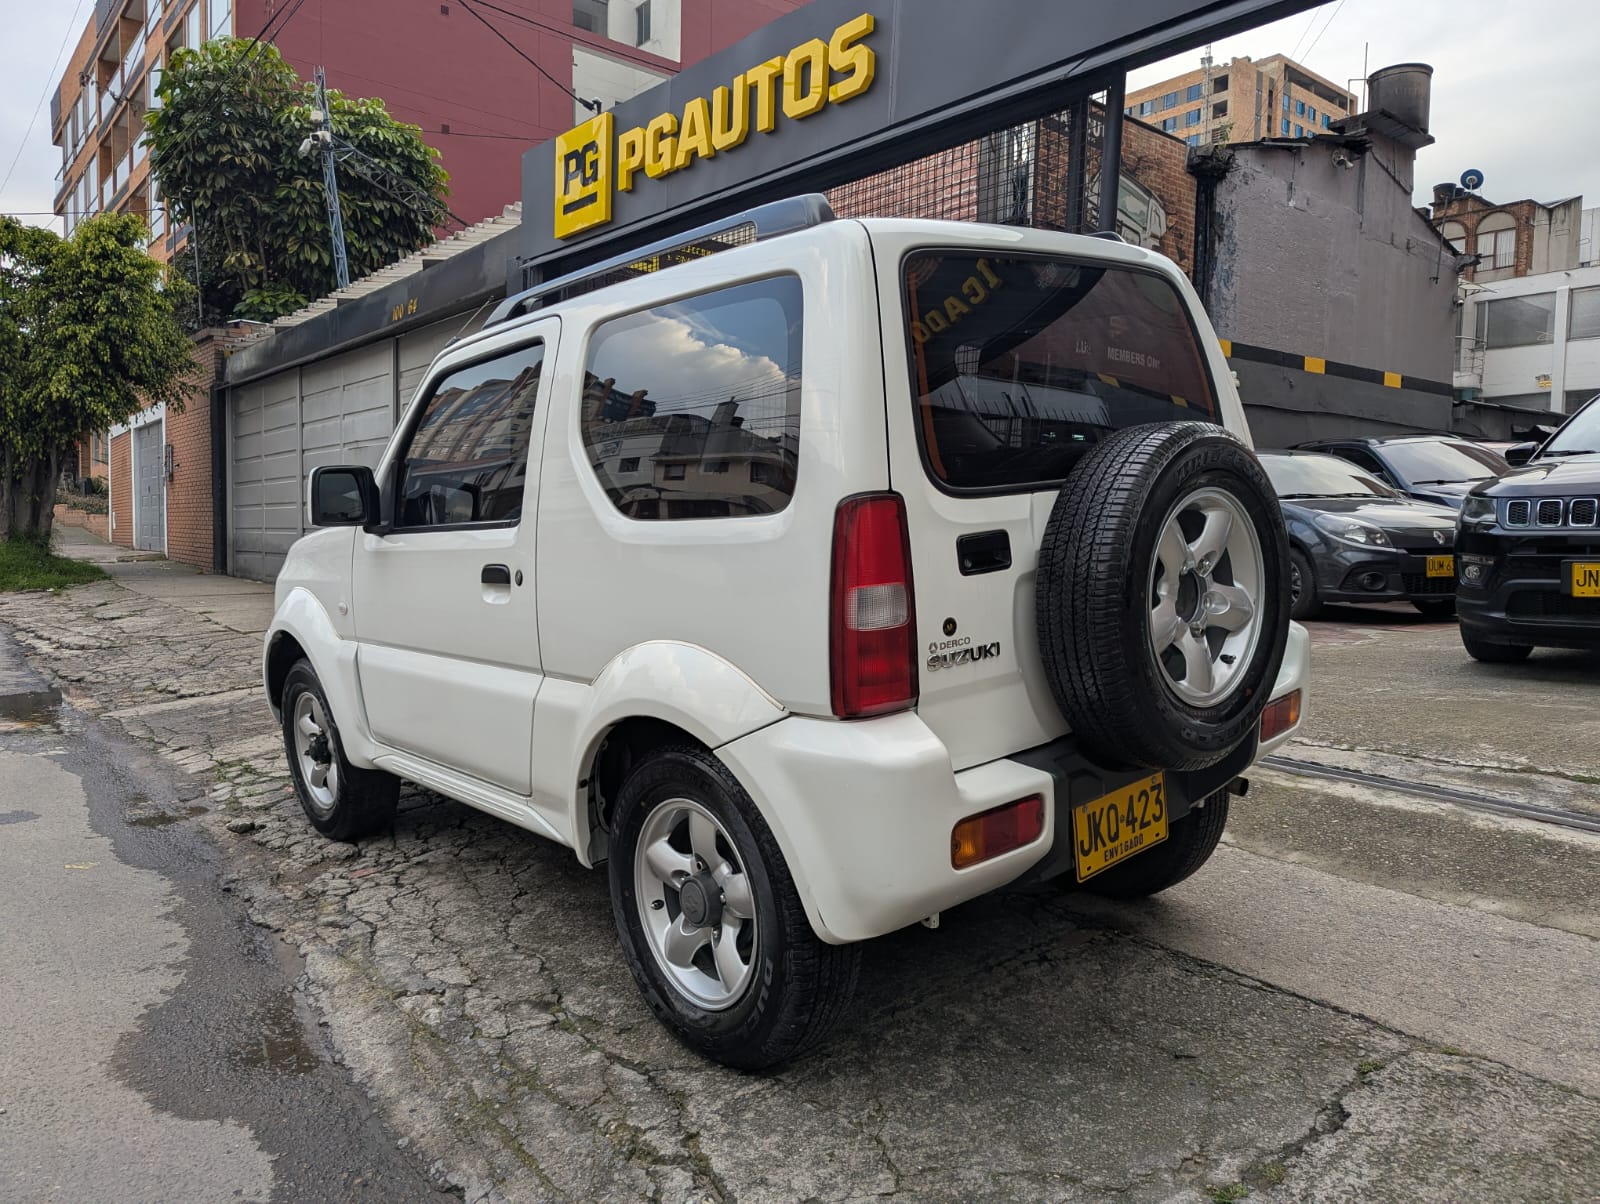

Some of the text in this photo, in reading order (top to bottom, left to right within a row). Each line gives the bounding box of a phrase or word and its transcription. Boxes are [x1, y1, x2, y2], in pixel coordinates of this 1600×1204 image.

[617, 12, 876, 193] PGAUTOS
[563, 140, 599, 195] PG
[1107, 346, 1145, 367] MEMBERS
[926, 641, 1001, 673] SUZUKI
[939, 636, 971, 651] DERCO
[1103, 833, 1144, 862] ENVIGADO
